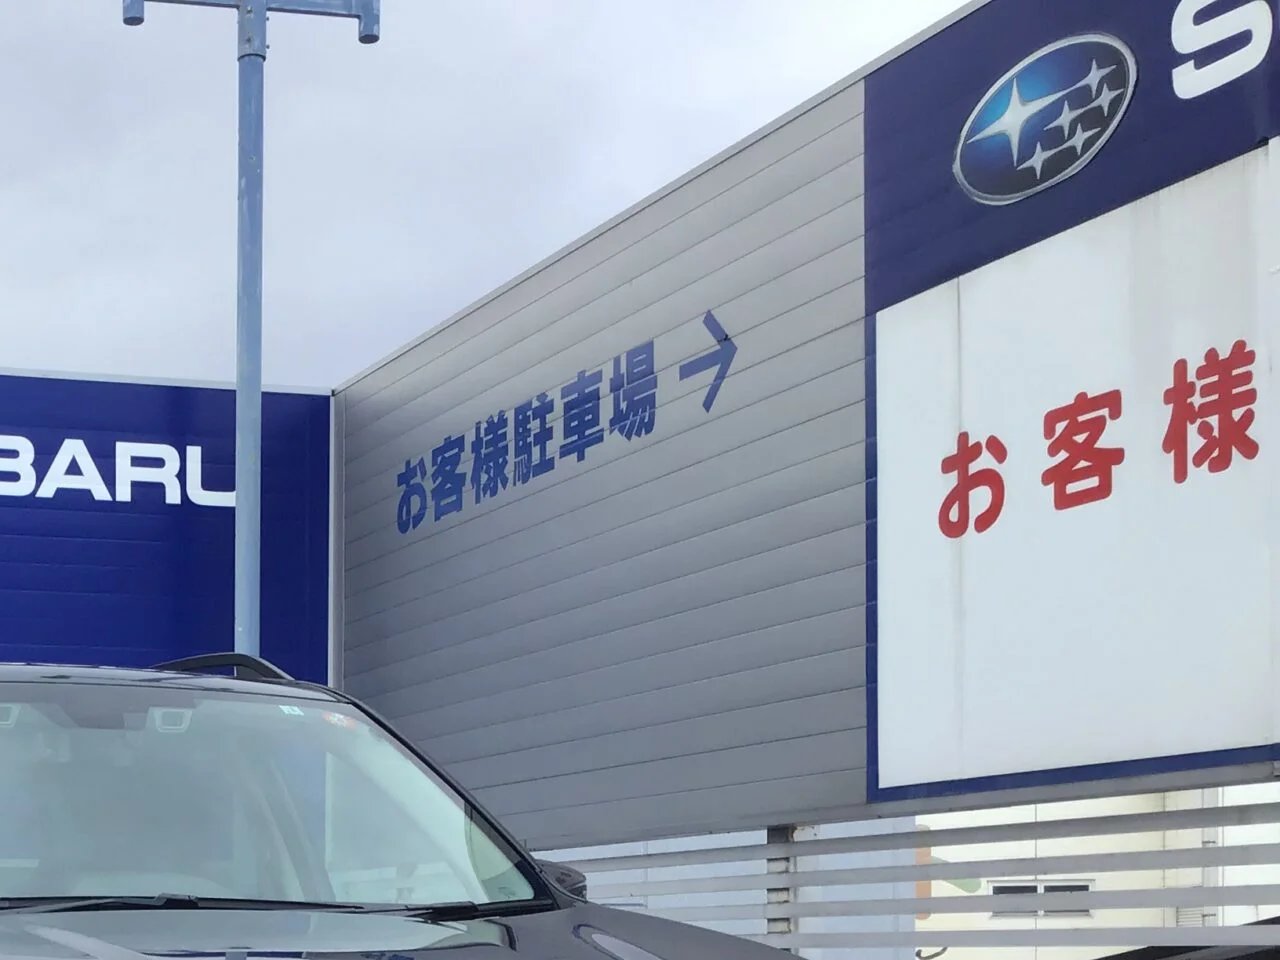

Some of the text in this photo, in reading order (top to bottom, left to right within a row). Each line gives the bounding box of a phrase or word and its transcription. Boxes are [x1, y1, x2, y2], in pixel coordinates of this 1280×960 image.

[396, 340, 658, 534] お客様駐車場
[938, 339, 1260, 539] お客様
